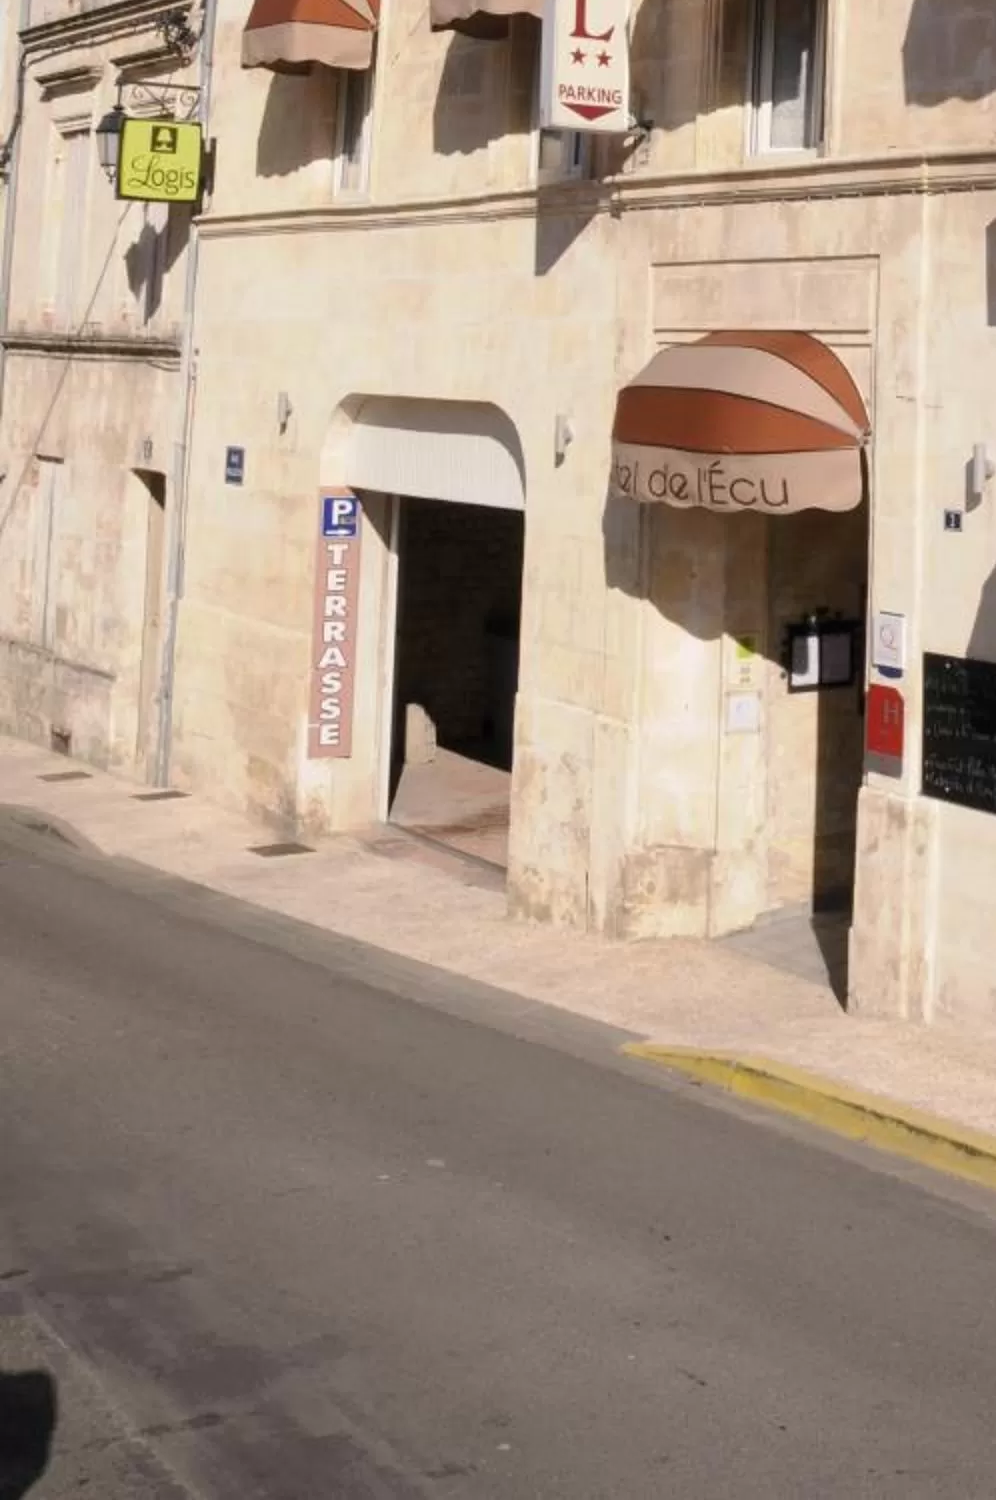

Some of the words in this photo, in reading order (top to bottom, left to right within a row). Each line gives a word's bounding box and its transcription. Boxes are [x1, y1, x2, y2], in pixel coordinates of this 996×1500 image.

[558, 83, 623, 105] PARKING
[128, 154, 195, 196] Logis
[648, 462, 689, 500] de
[332, 499, 353, 526] P
[318, 544, 349, 746] TERRASSE
